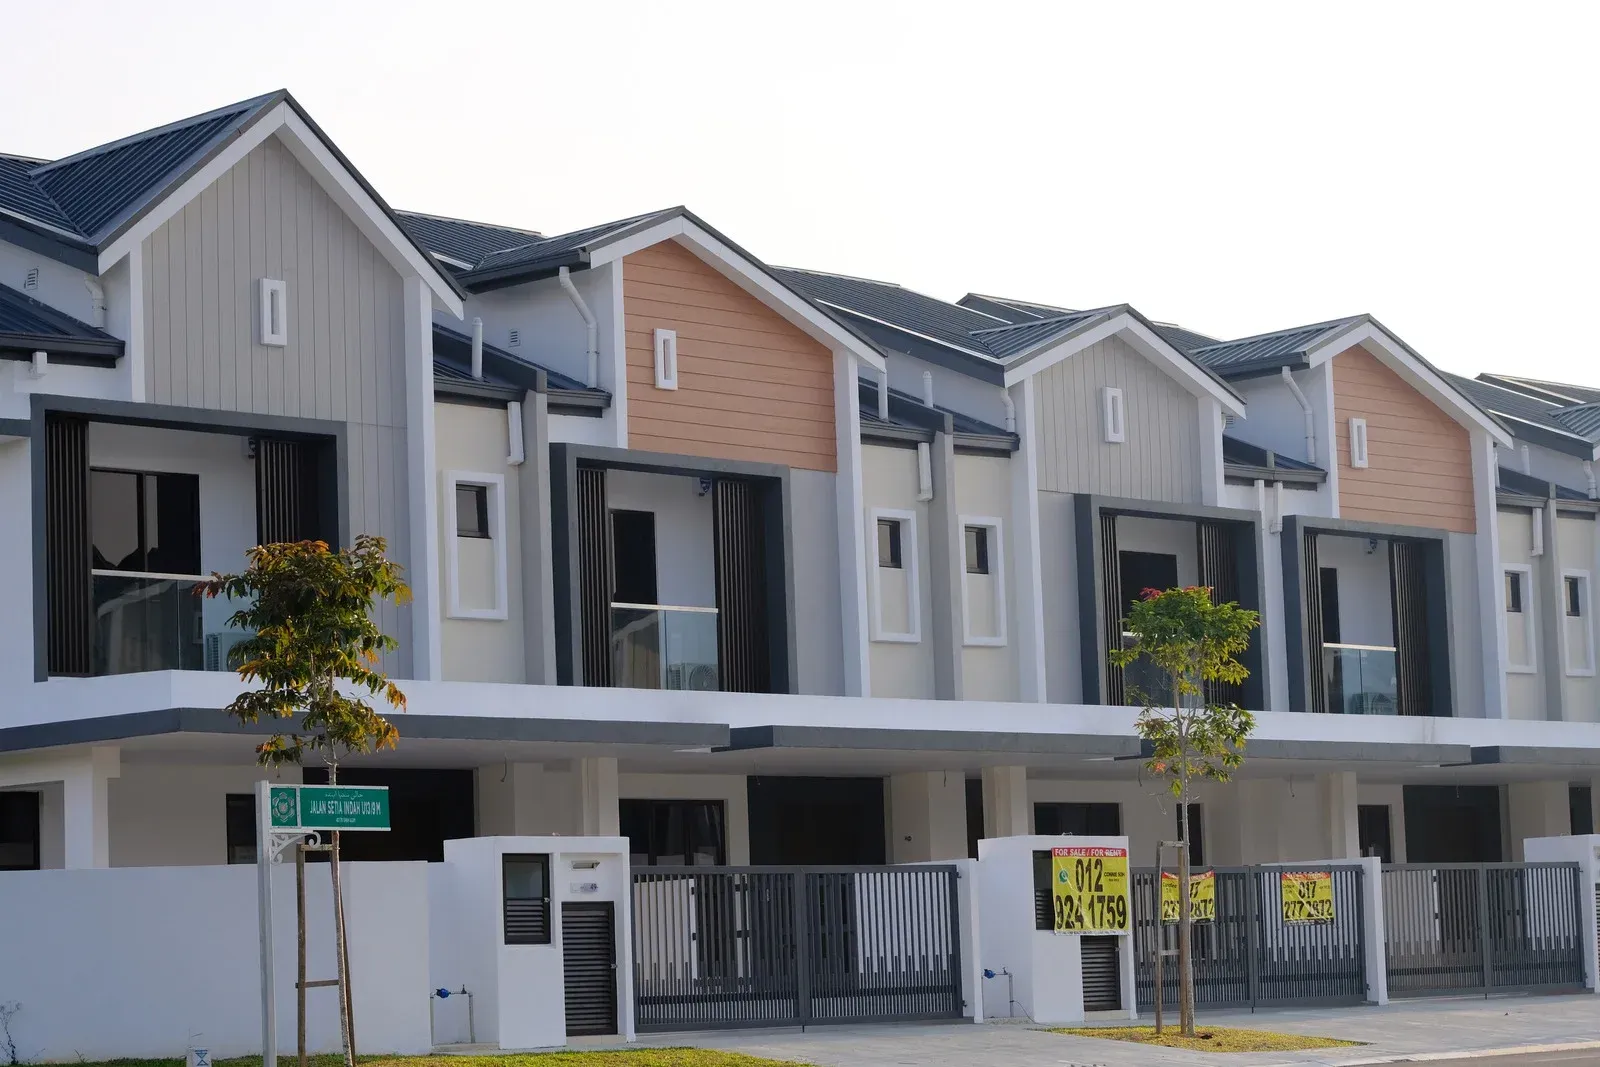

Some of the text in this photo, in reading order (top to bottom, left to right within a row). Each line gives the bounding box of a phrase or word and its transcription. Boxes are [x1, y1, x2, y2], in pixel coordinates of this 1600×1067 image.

[310, 800, 326, 814] JALAN
[327, 800, 343, 815] SETIA
[343, 801, 361, 815] INDAH
[1055, 848, 1068, 856] FOR
[1069, 848, 1086, 857] SALE
[1091, 848, 1104, 857] FOR
[1105, 849, 1121, 857] RENT
[1075, 858, 1103, 893] 012
[1298, 881, 1317, 898] 017
[1056, 894, 1127, 929] 924 1759
[1284, 900, 1304, 919] 277
